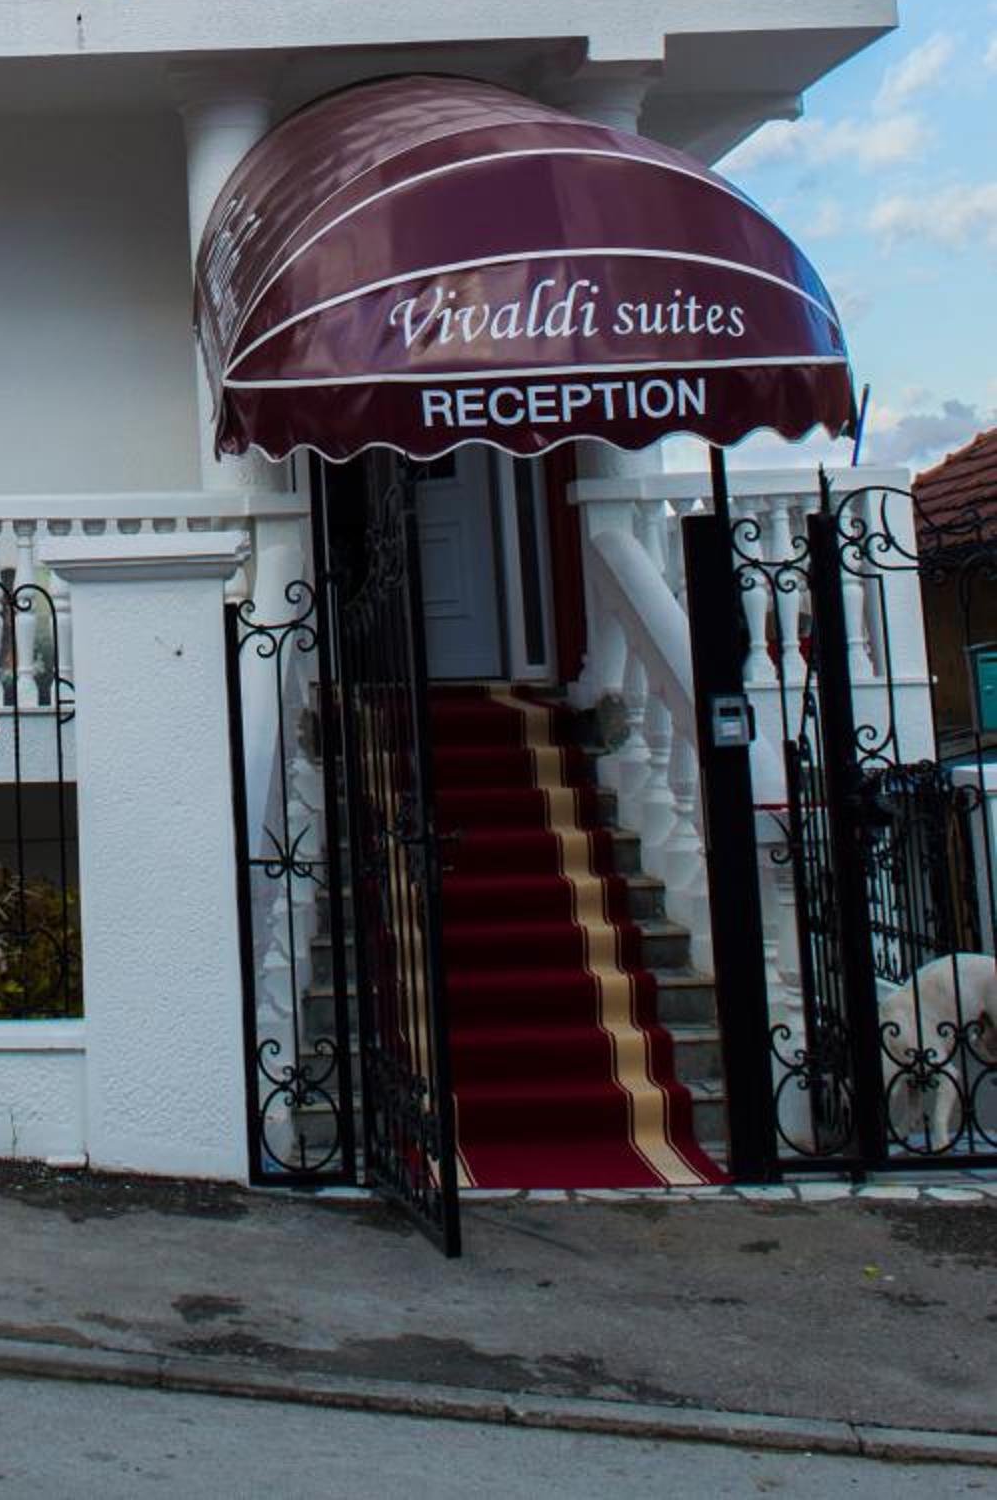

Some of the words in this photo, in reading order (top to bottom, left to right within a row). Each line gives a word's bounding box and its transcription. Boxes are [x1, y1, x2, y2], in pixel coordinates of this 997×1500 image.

[389, 279, 599, 347] Vivaldi
[612, 290, 745, 337] suites
[422, 378, 707, 428] RECEPTION
